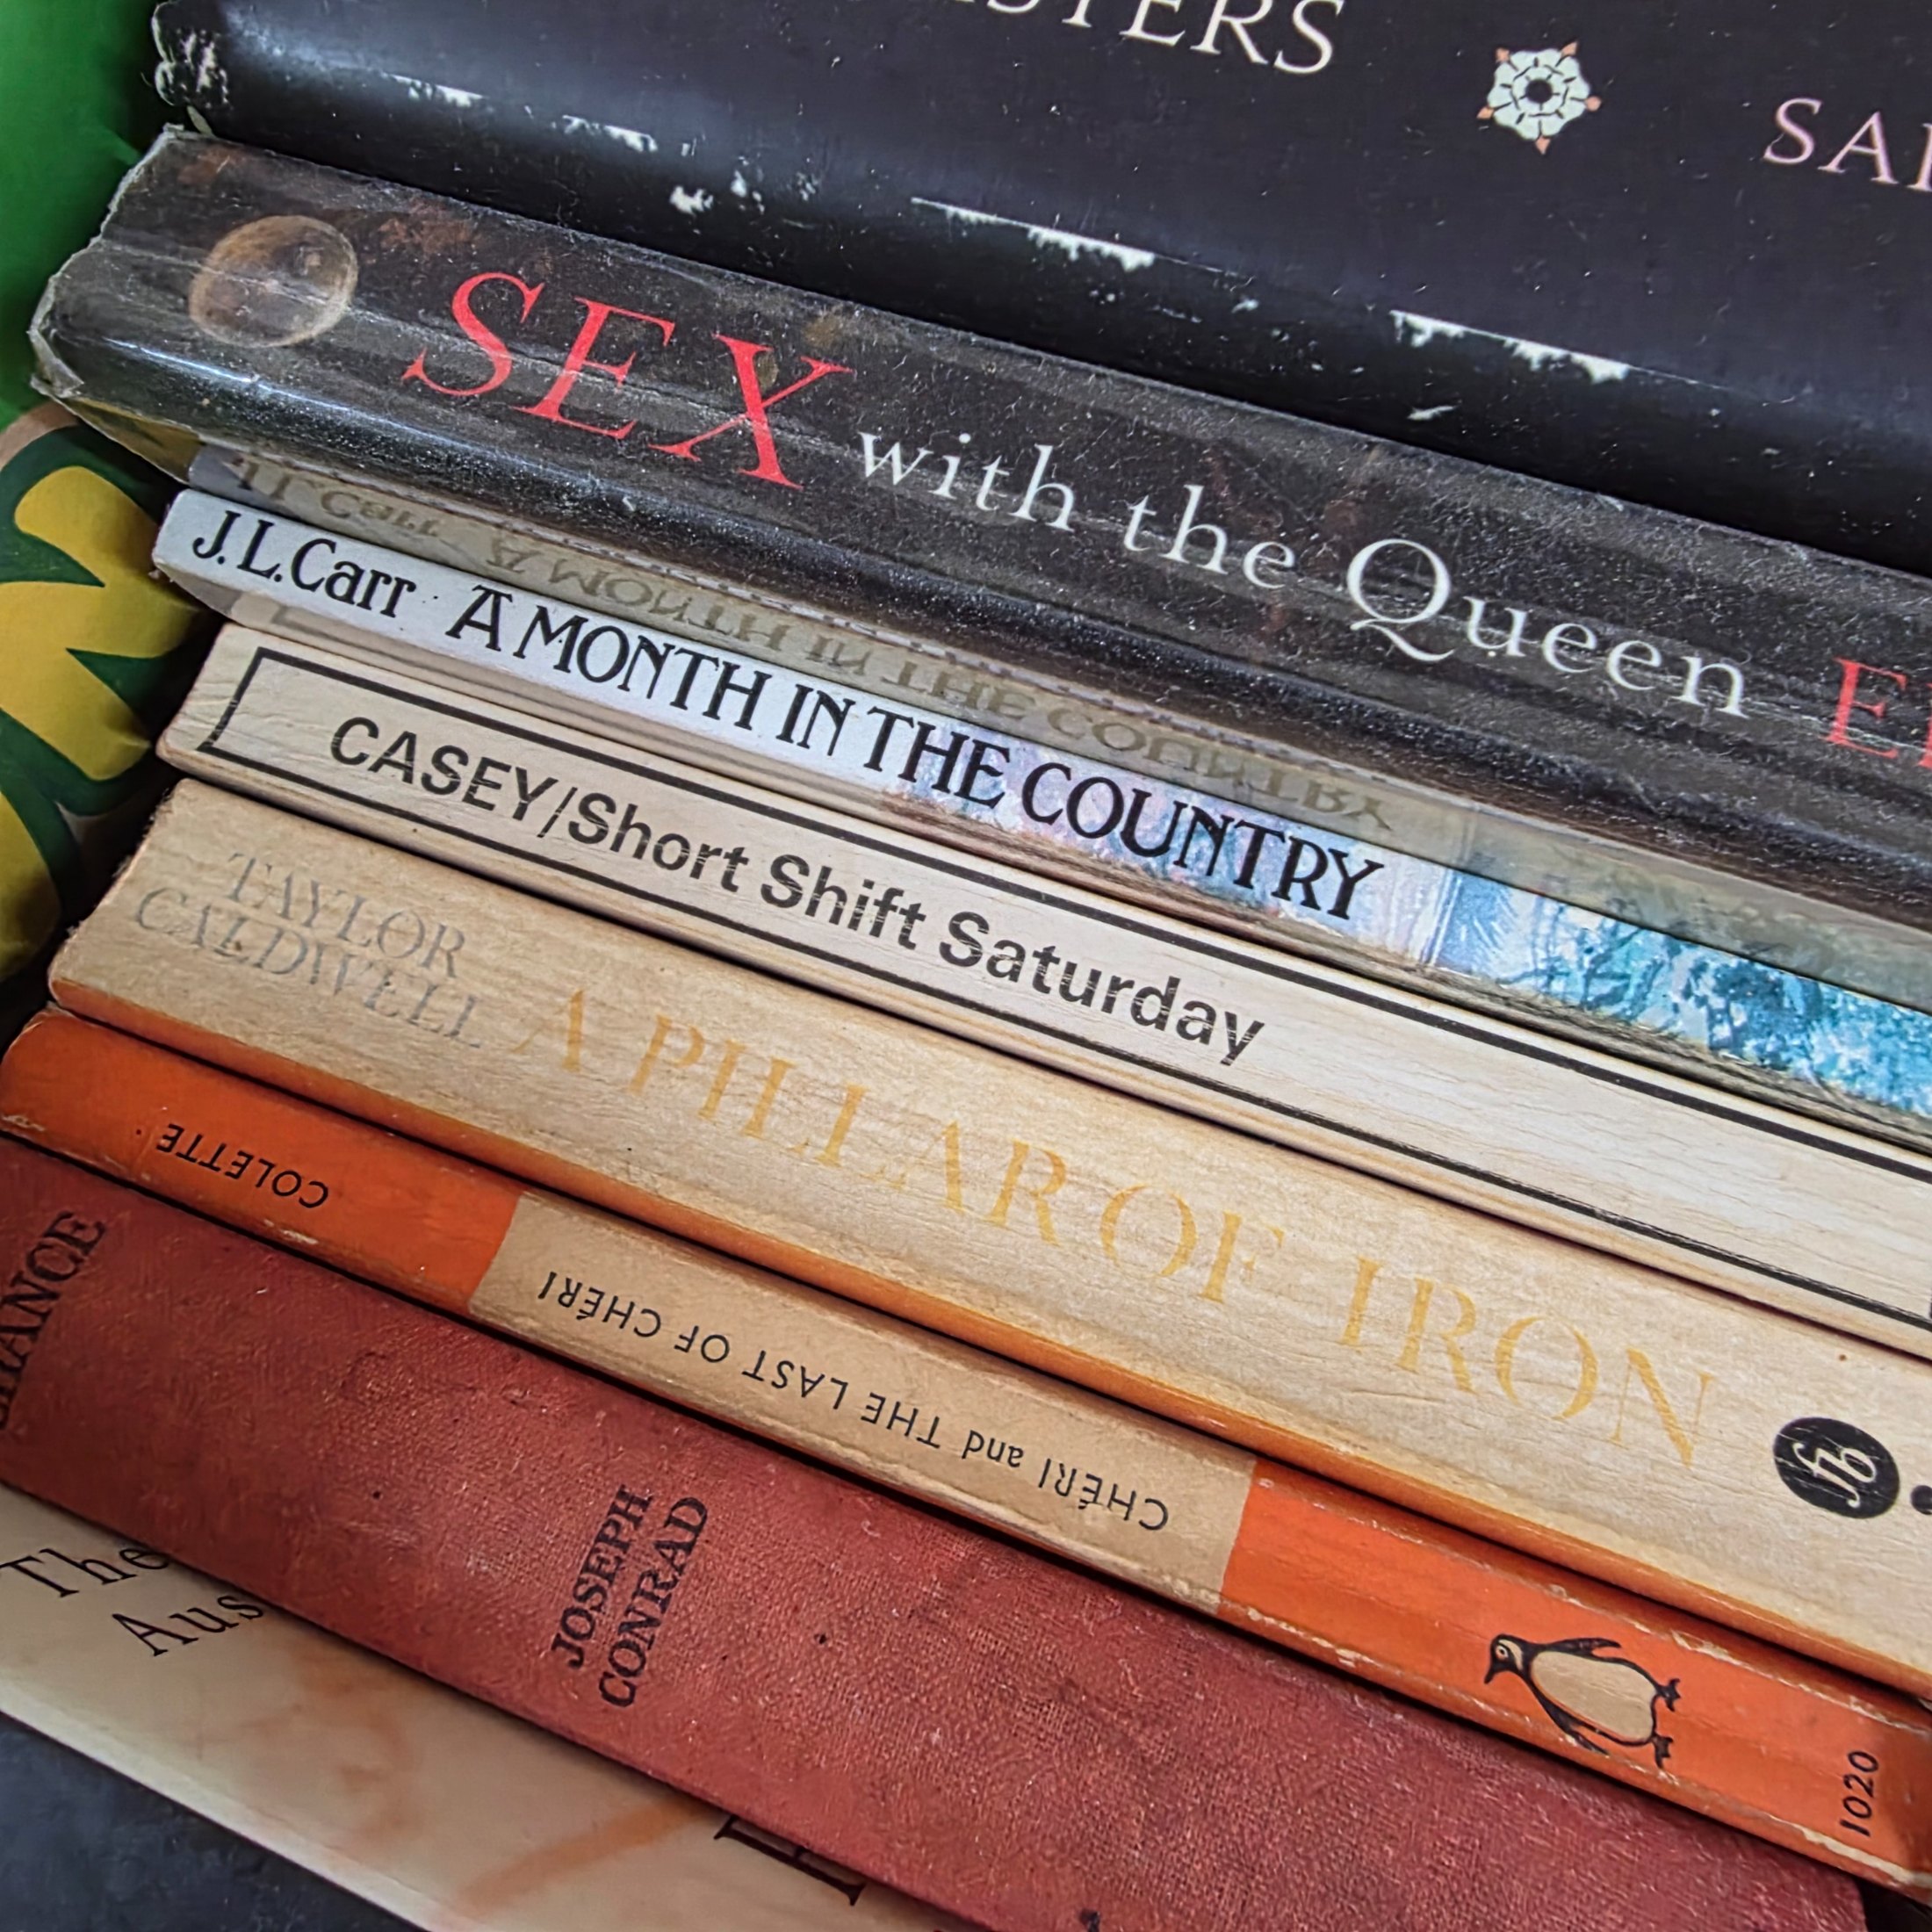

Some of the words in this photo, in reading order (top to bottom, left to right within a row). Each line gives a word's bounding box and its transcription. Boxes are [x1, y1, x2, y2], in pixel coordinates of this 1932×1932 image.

[400, 272, 854, 489] SEX
[858, 431, 1074, 531] with
[1123, 485, 1295, 588] the
[1346, 539, 1748, 719] Queen
[445, 584, 513, 652] A
[513, 605, 772, 731] MONTH
[783, 683, 856, 757] IN
[863, 705, 1011, 810] THE
[1021, 761, 1385, 920] COUNTRY
[1818, 656, 1932, 769] E
[229, 852, 465, 979] TAYLOR
[329, 717, 749, 893] CASEY/Short
[761, 854, 926, 951] Shift
[939, 910, 1265, 1066] Saturday
[135, 886, 482, 1049] CALDWELL
[156, 1122, 330, 1210] COLETTE
[513, 989, 585, 1073] A
[628, 1013, 1067, 1245] PILLAR
[1099, 1185, 1285, 1303] OF
[1339, 1256, 1715, 1468] IRON
[0, 1210, 106, 1431] ANCE
[537, 1271, 662, 1339] CHÉRI
[674, 1330, 731, 1364] OF
[742, 1350, 849, 1410] LAST
[861, 1391, 941, 1448] THE
[962, 1428, 1026, 1469] and
[1037, 1457, 1170, 1532] CHÉRI
[0, 1547, 169, 1598] The
[551, 1484, 654, 1669] JOSEPH
[598, 1495, 709, 1709] CONRAD
[1841, 1749, 1880, 1837] 1020
